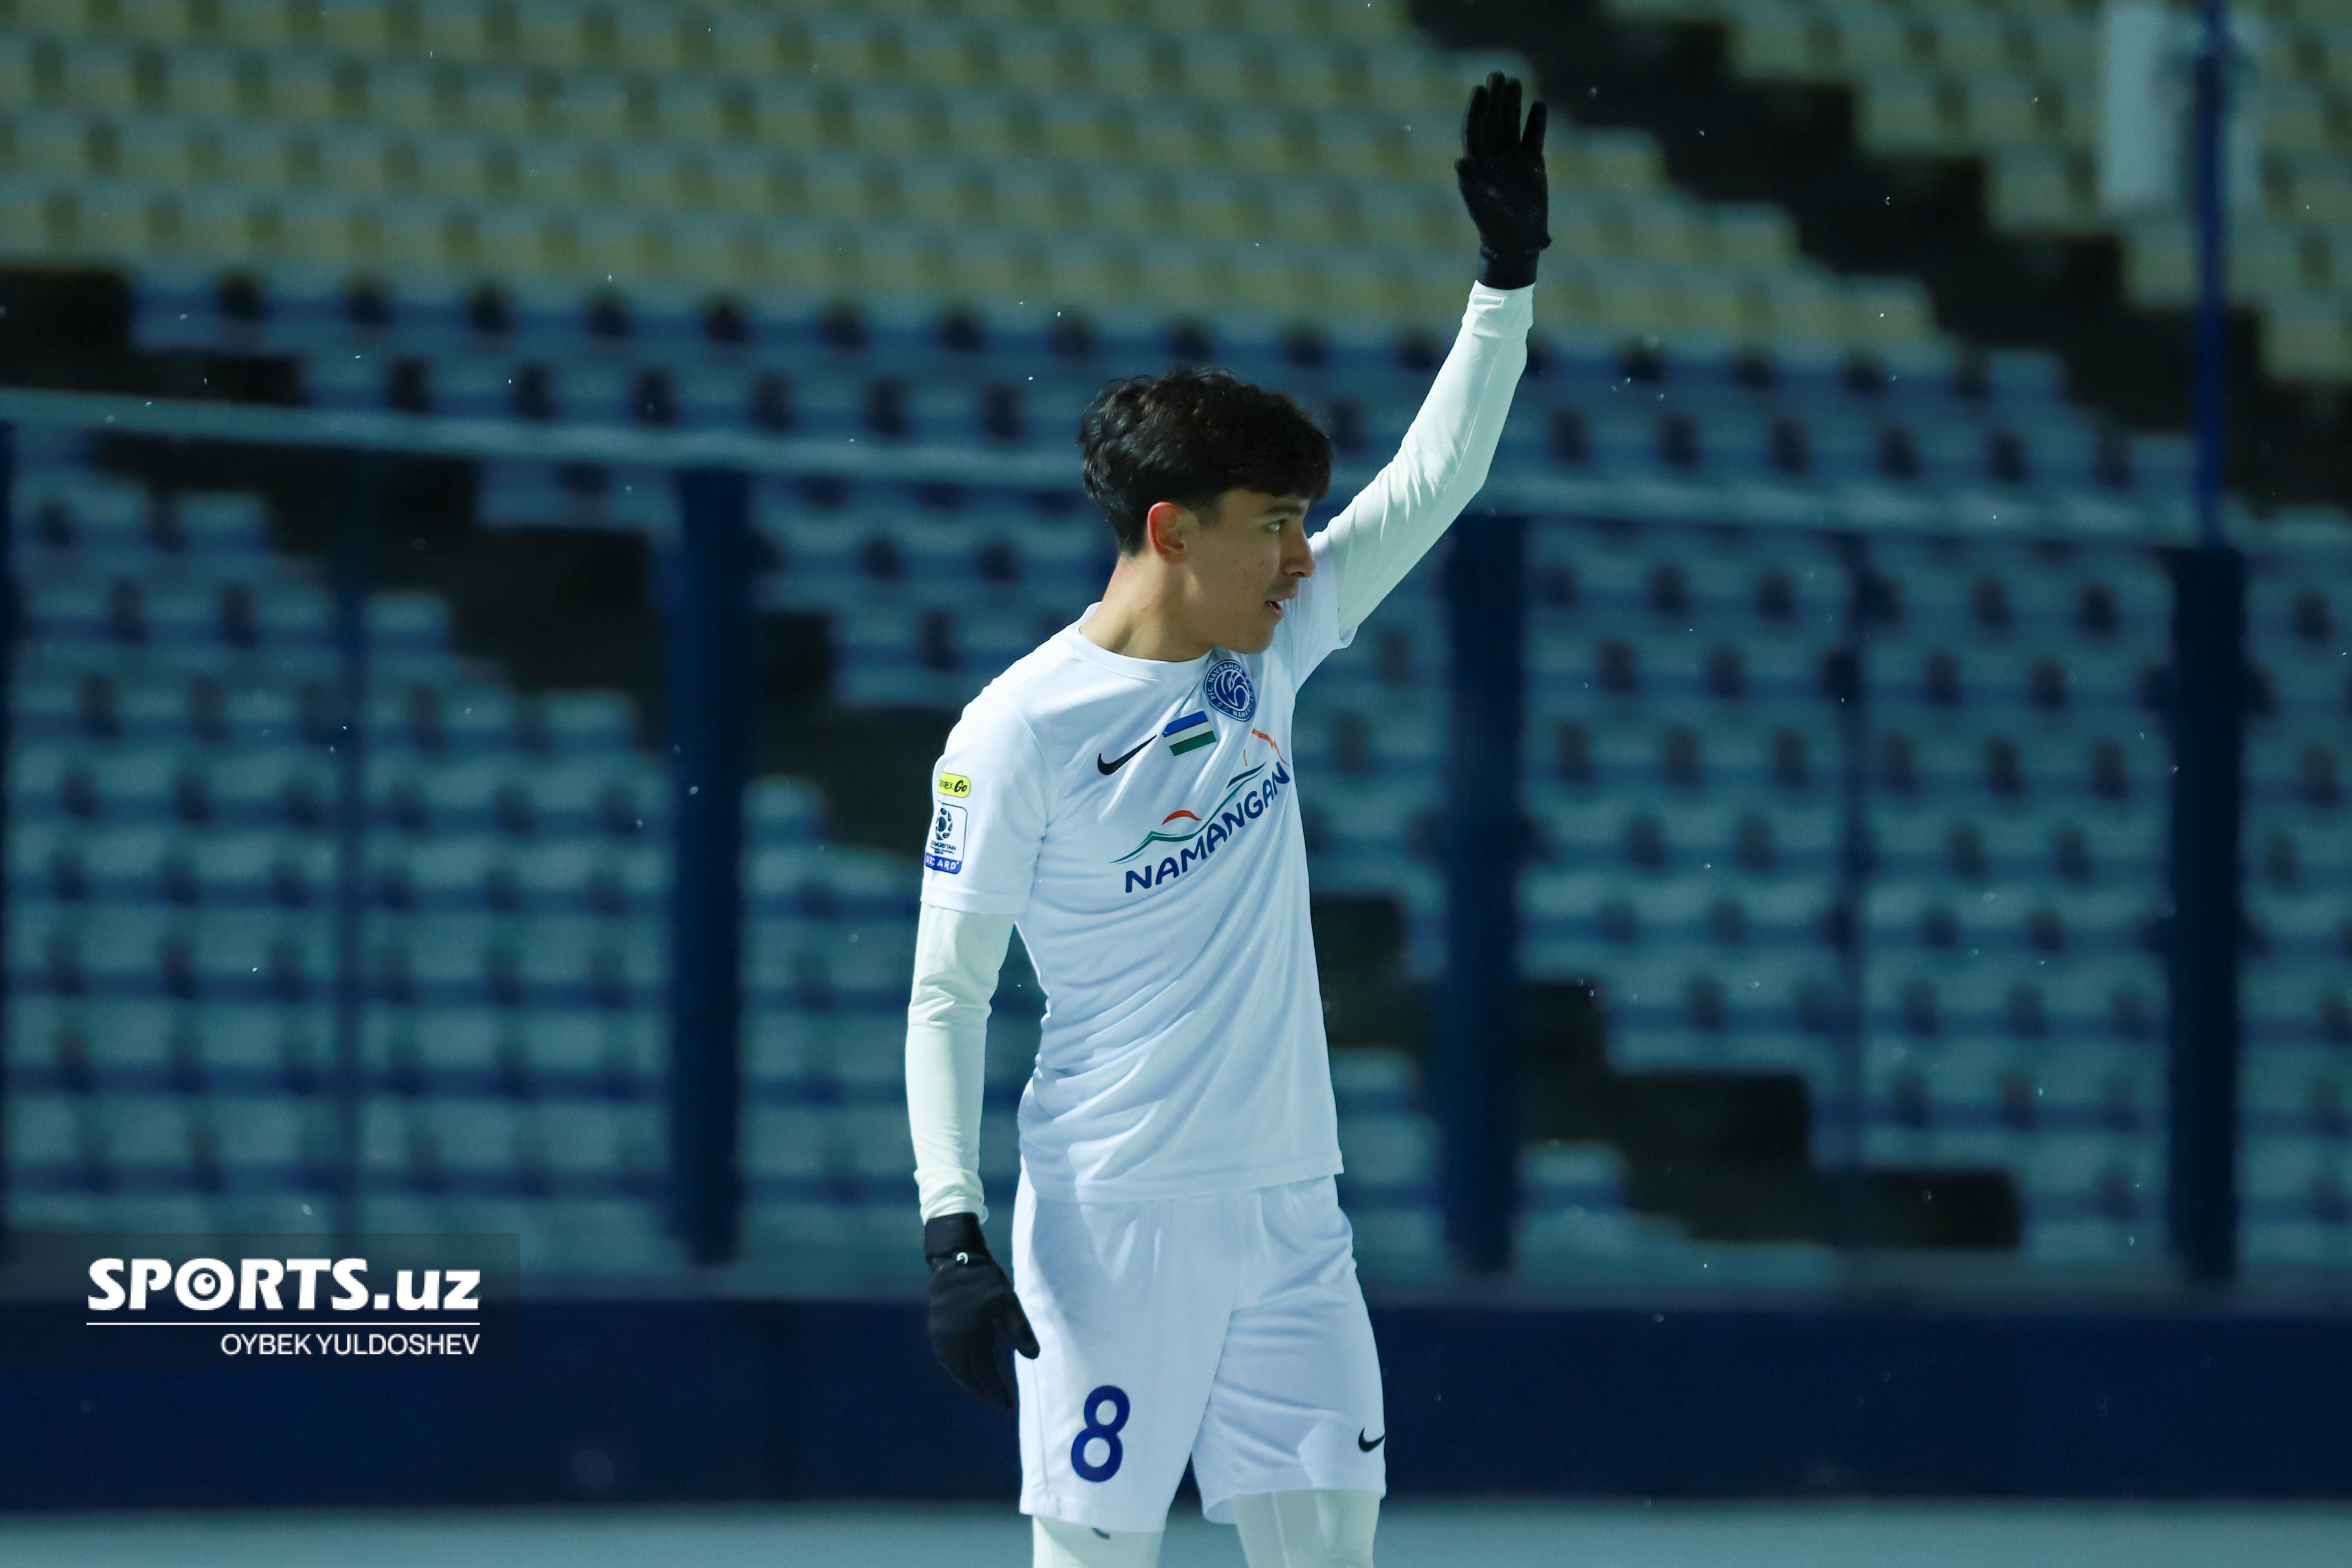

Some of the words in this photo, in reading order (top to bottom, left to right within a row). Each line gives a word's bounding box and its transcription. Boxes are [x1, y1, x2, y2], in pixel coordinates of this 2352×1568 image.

[954, 780, 968, 792] Go
[1125, 761, 1290, 893] NAMANGAN
[1071, 1385, 1130, 1483] 8
